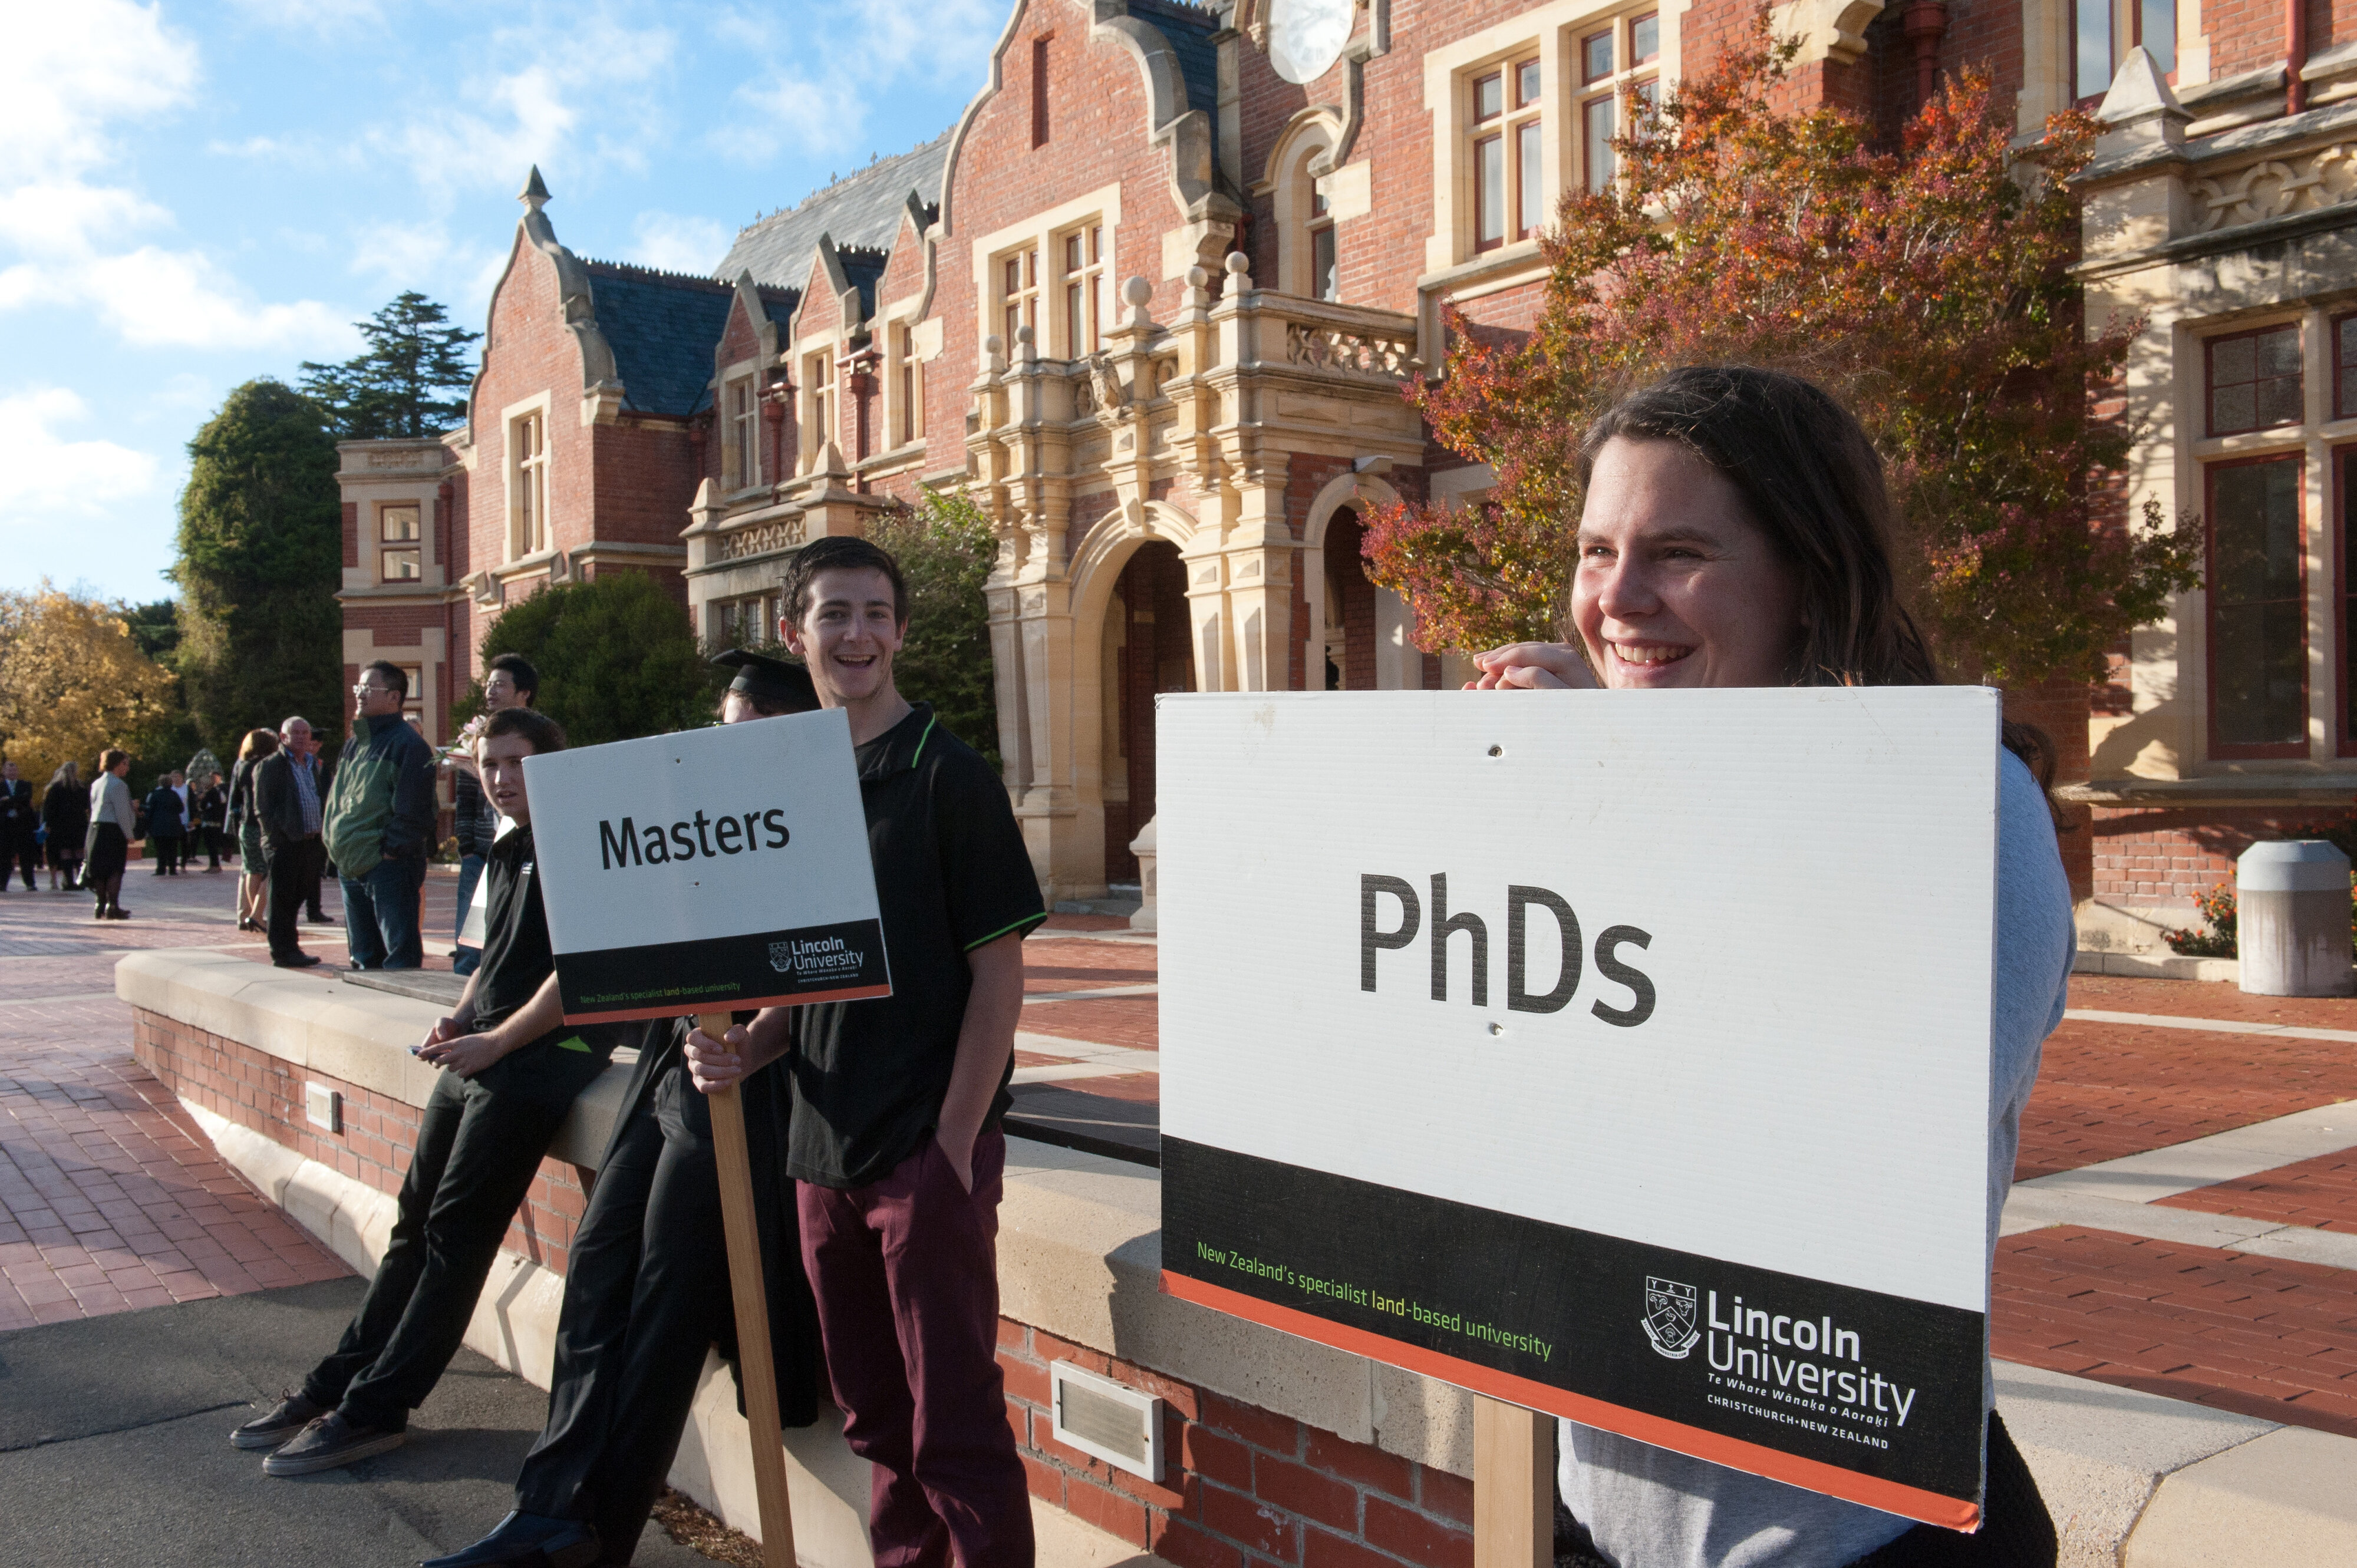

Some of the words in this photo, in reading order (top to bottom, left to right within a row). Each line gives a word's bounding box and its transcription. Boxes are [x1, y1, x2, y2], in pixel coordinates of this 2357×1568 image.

[599, 808, 790, 870] Masters
[792, 937, 844, 955] Lincoln
[794, 950, 863, 970] University
[1361, 872, 1656, 1028] PhDs
[581, 995, 595, 1003] New
[631, 989, 662, 1001] specialist
[664, 984, 704, 996] land-based
[705, 982, 740, 992] university
[1198, 1242, 1226, 1265] New
[1298, 1275, 1367, 1306] specialist
[1372, 1290, 1461, 1332] land-based
[1466, 1322, 1552, 1362] university
[1709, 1290, 1860, 1362] Lincoln
[1708, 1330, 1916, 1427] University
[1709, 1372, 1721, 1384] Te
[1727, 1377, 1767, 1397] Whare
[1832, 1427, 1888, 1449] ZEALAND
